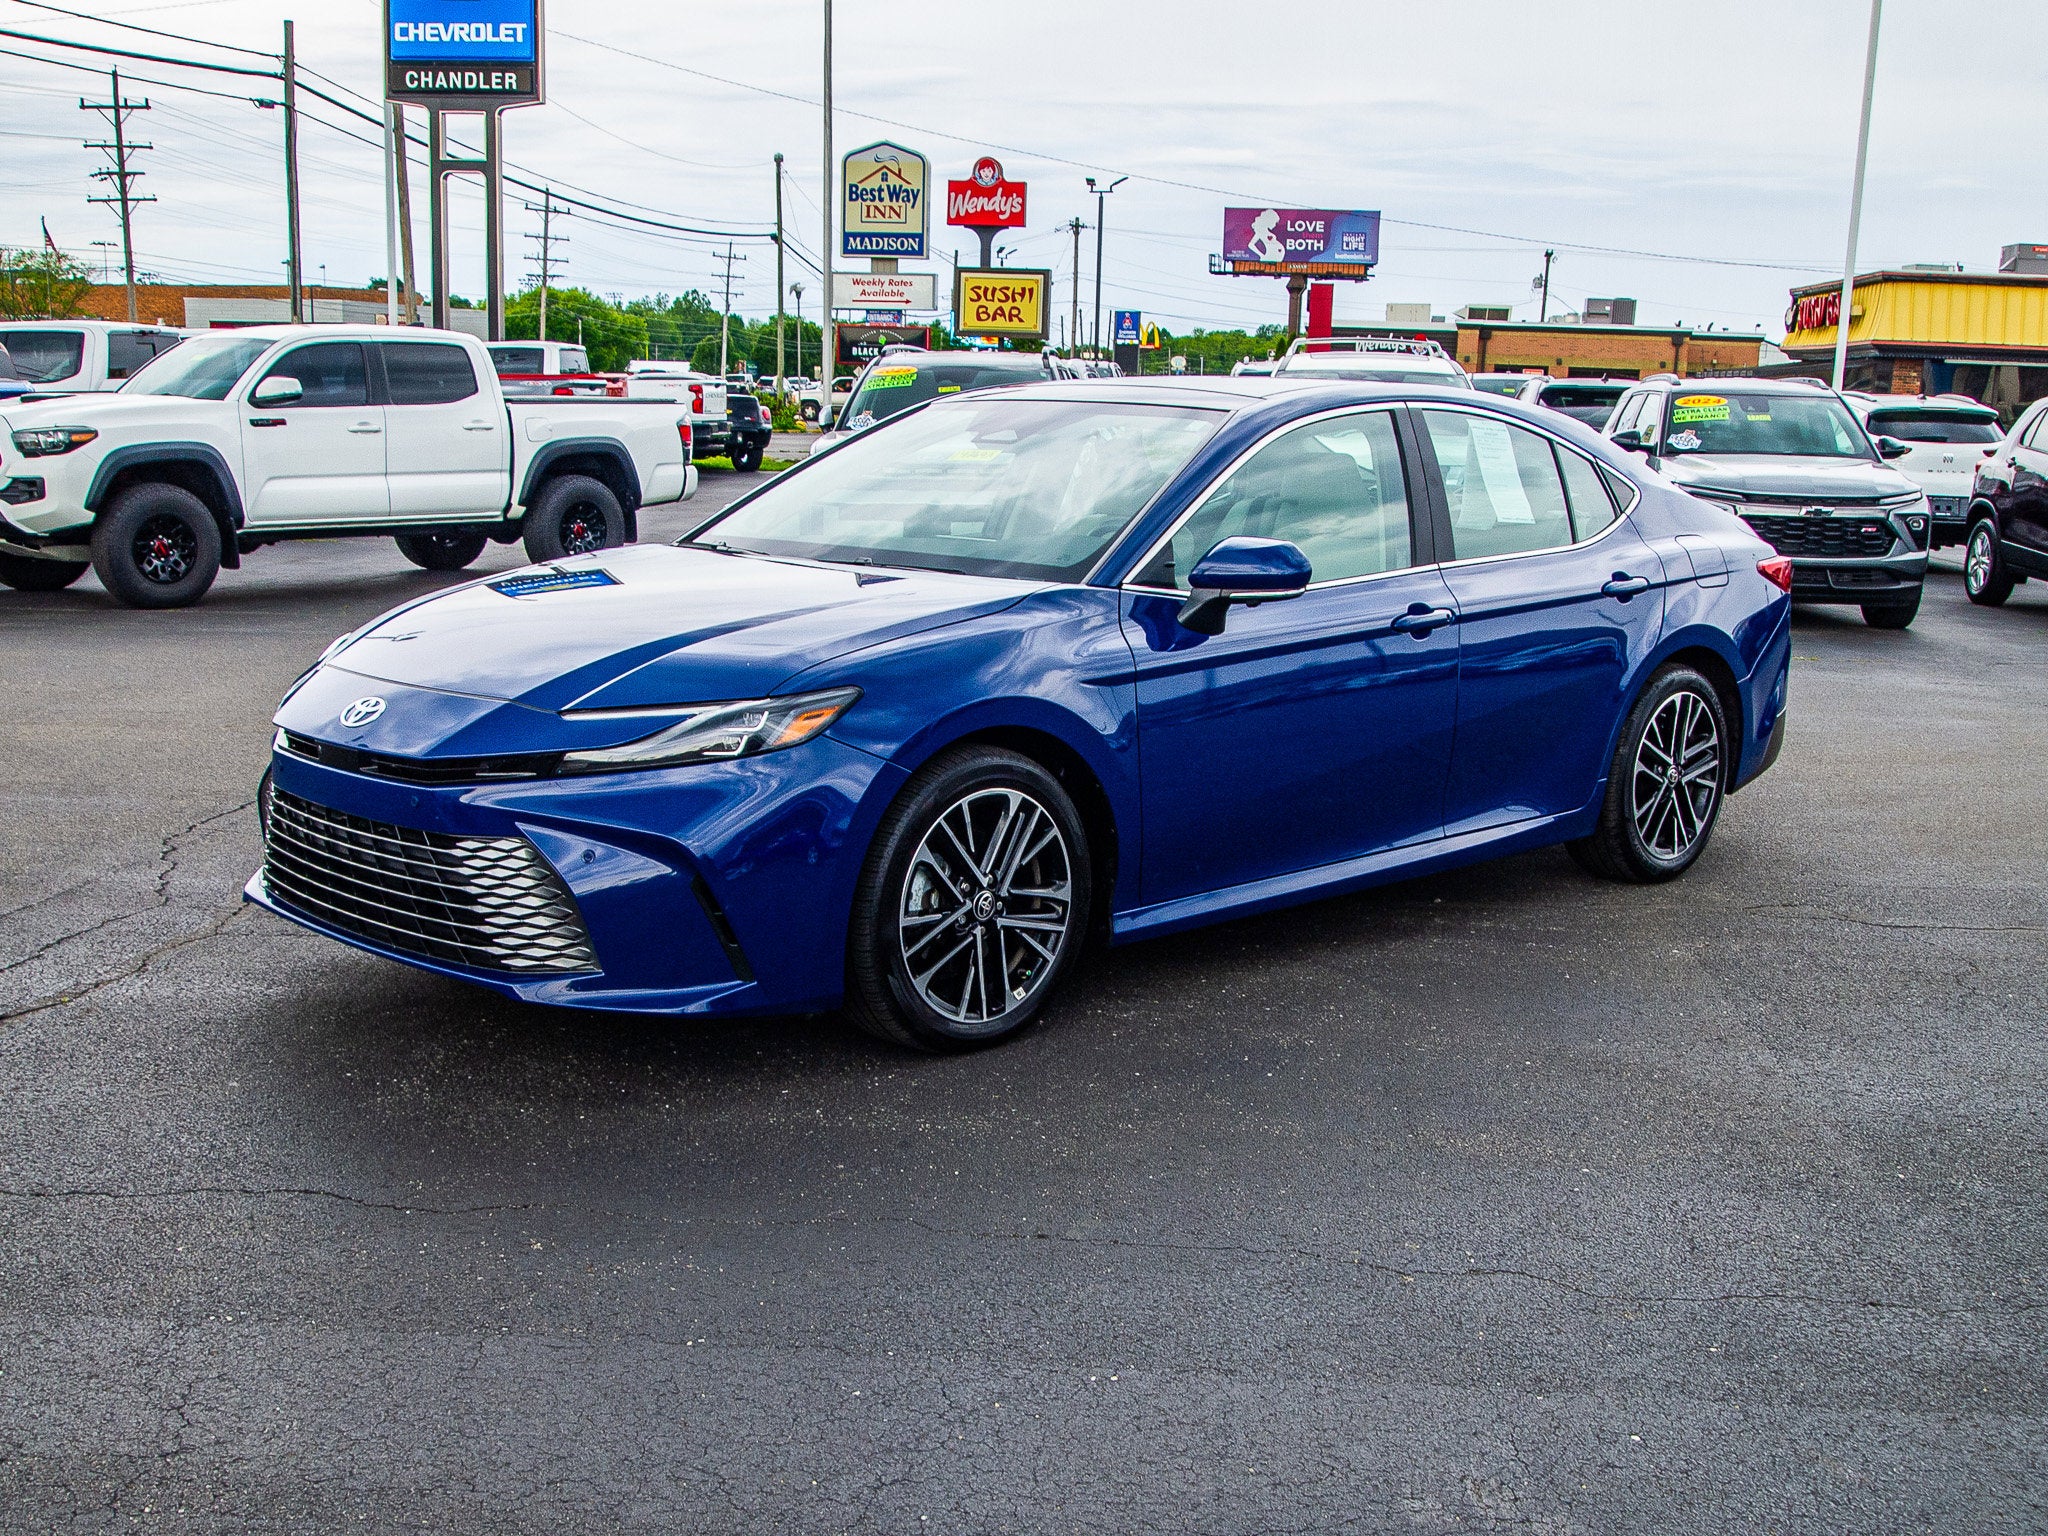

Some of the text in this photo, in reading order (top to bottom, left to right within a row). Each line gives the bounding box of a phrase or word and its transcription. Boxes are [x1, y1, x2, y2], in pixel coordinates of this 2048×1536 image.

[394, 22, 527, 42] CHEVROLET
[405, 70, 517, 90] CHANDLER
[849, 183, 920, 209] Best Way
[950, 188, 1022, 219] Wendy's
[865, 205, 902, 219] INN
[1286, 220, 1325, 233] LOVE
[848, 237, 919, 251] MADISON
[1286, 239, 1324, 251] BOTH
[1343, 242, 1365, 251] LIFE
[852, 278, 913, 288] Weekly Rates
[860, 289, 905, 297] Available
[969, 285, 1034, 304] SUSHI
[975, 305, 1024, 323] BAR
[852, 347, 879, 356] BLACK
